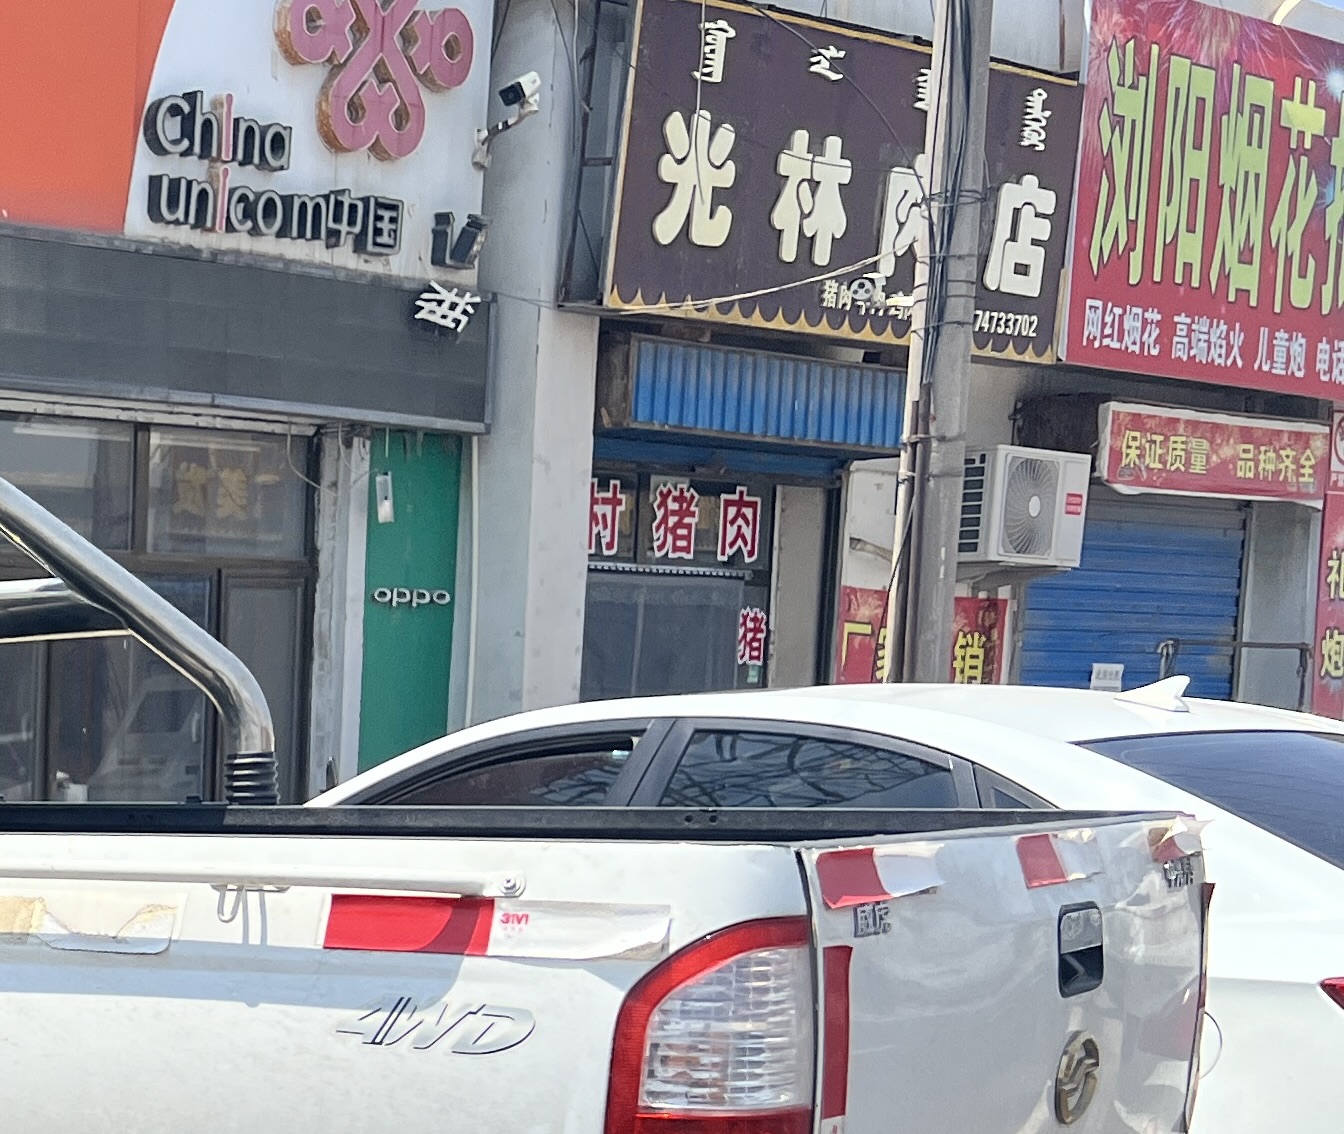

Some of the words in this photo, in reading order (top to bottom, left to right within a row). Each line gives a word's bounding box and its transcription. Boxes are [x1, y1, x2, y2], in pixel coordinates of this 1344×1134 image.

[1082, 298, 1162, 357] 网红烟花
[1172, 312, 1244, 369] 高端焰火
[1254, 326, 1306, 378] 儿童炮
[1121, 429, 1209, 475] 保证质量
[1237, 443, 1316, 483] 品种齐全
[737, 607, 767, 665] 猪
